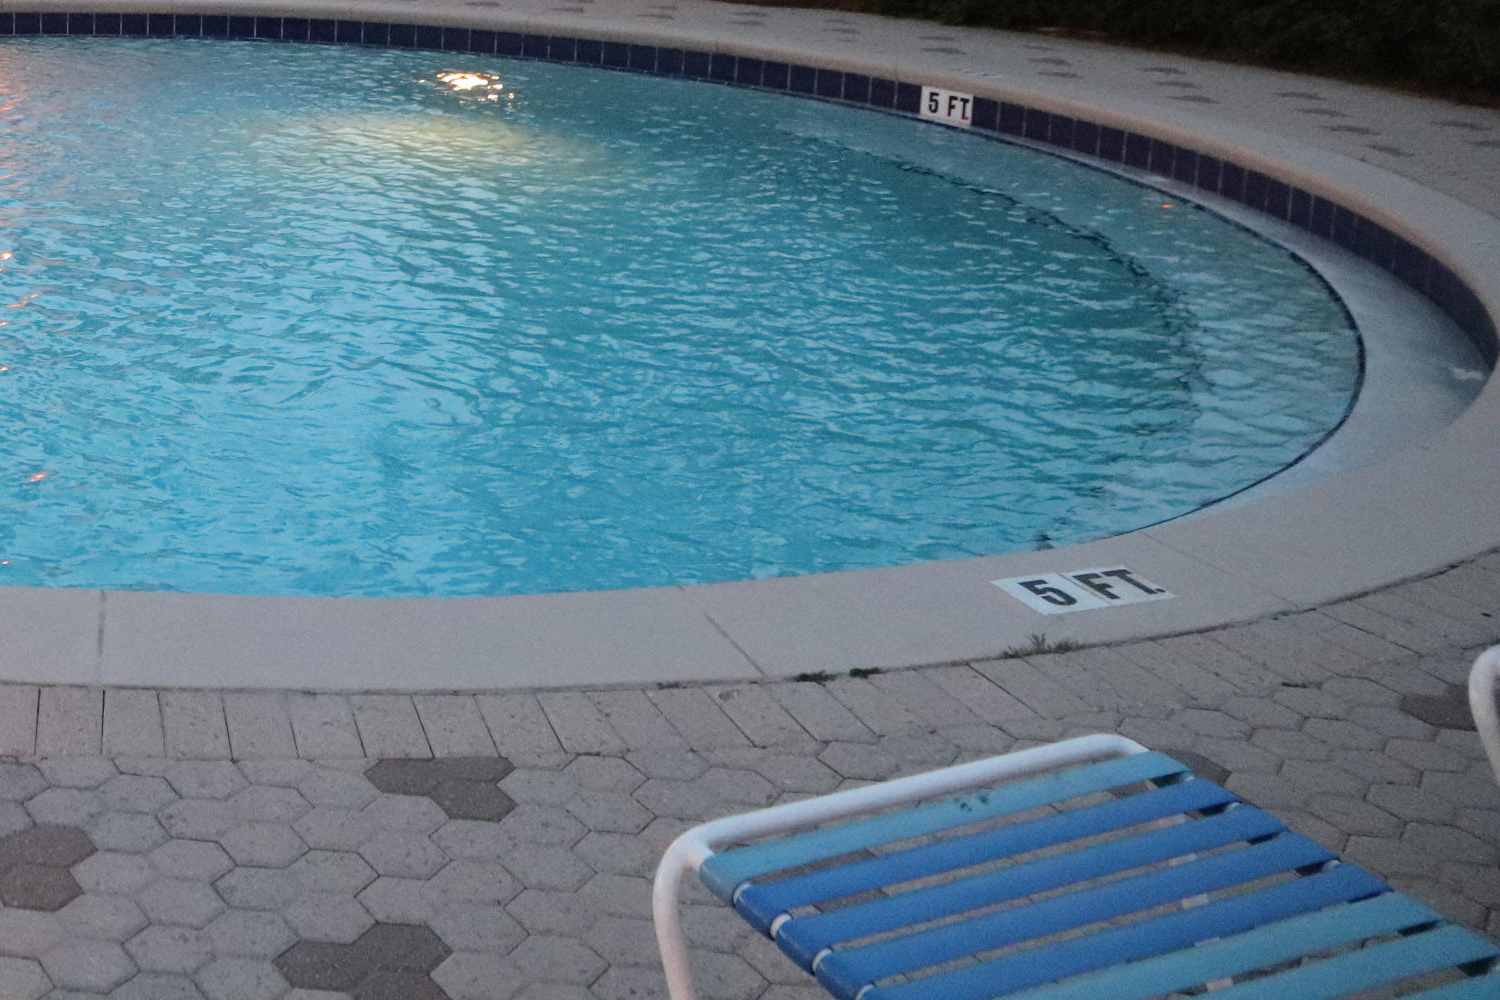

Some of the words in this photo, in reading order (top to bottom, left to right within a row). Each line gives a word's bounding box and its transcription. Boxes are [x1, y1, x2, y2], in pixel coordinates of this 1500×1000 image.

[929, 92, 940, 114] 5
[1017, 579, 1077, 606] 5
[1073, 569, 1166, 600] FT.
